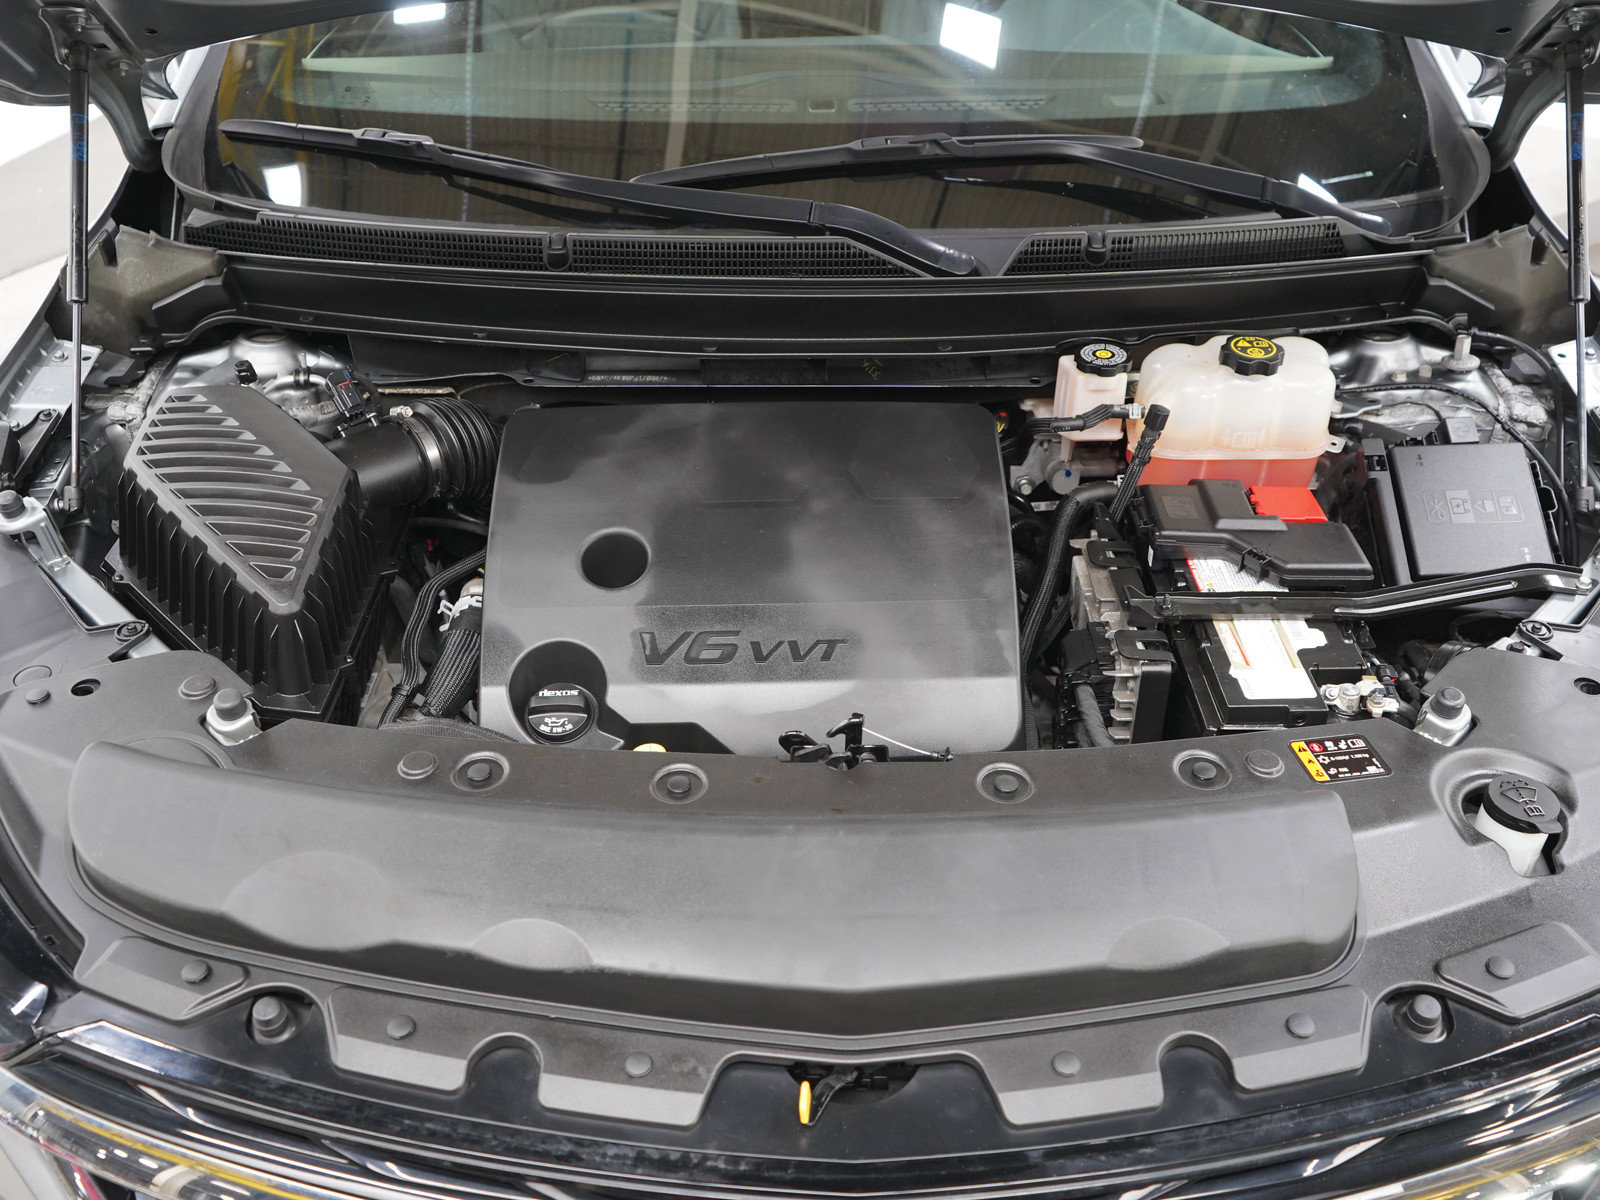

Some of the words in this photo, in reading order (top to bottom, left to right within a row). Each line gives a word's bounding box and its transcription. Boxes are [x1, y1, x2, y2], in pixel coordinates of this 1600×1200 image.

[639, 630, 742, 666] V6
[750, 638, 850, 664] VVT
[538, 689, 580, 697] dexos
[539, 724, 552, 733] SAE
